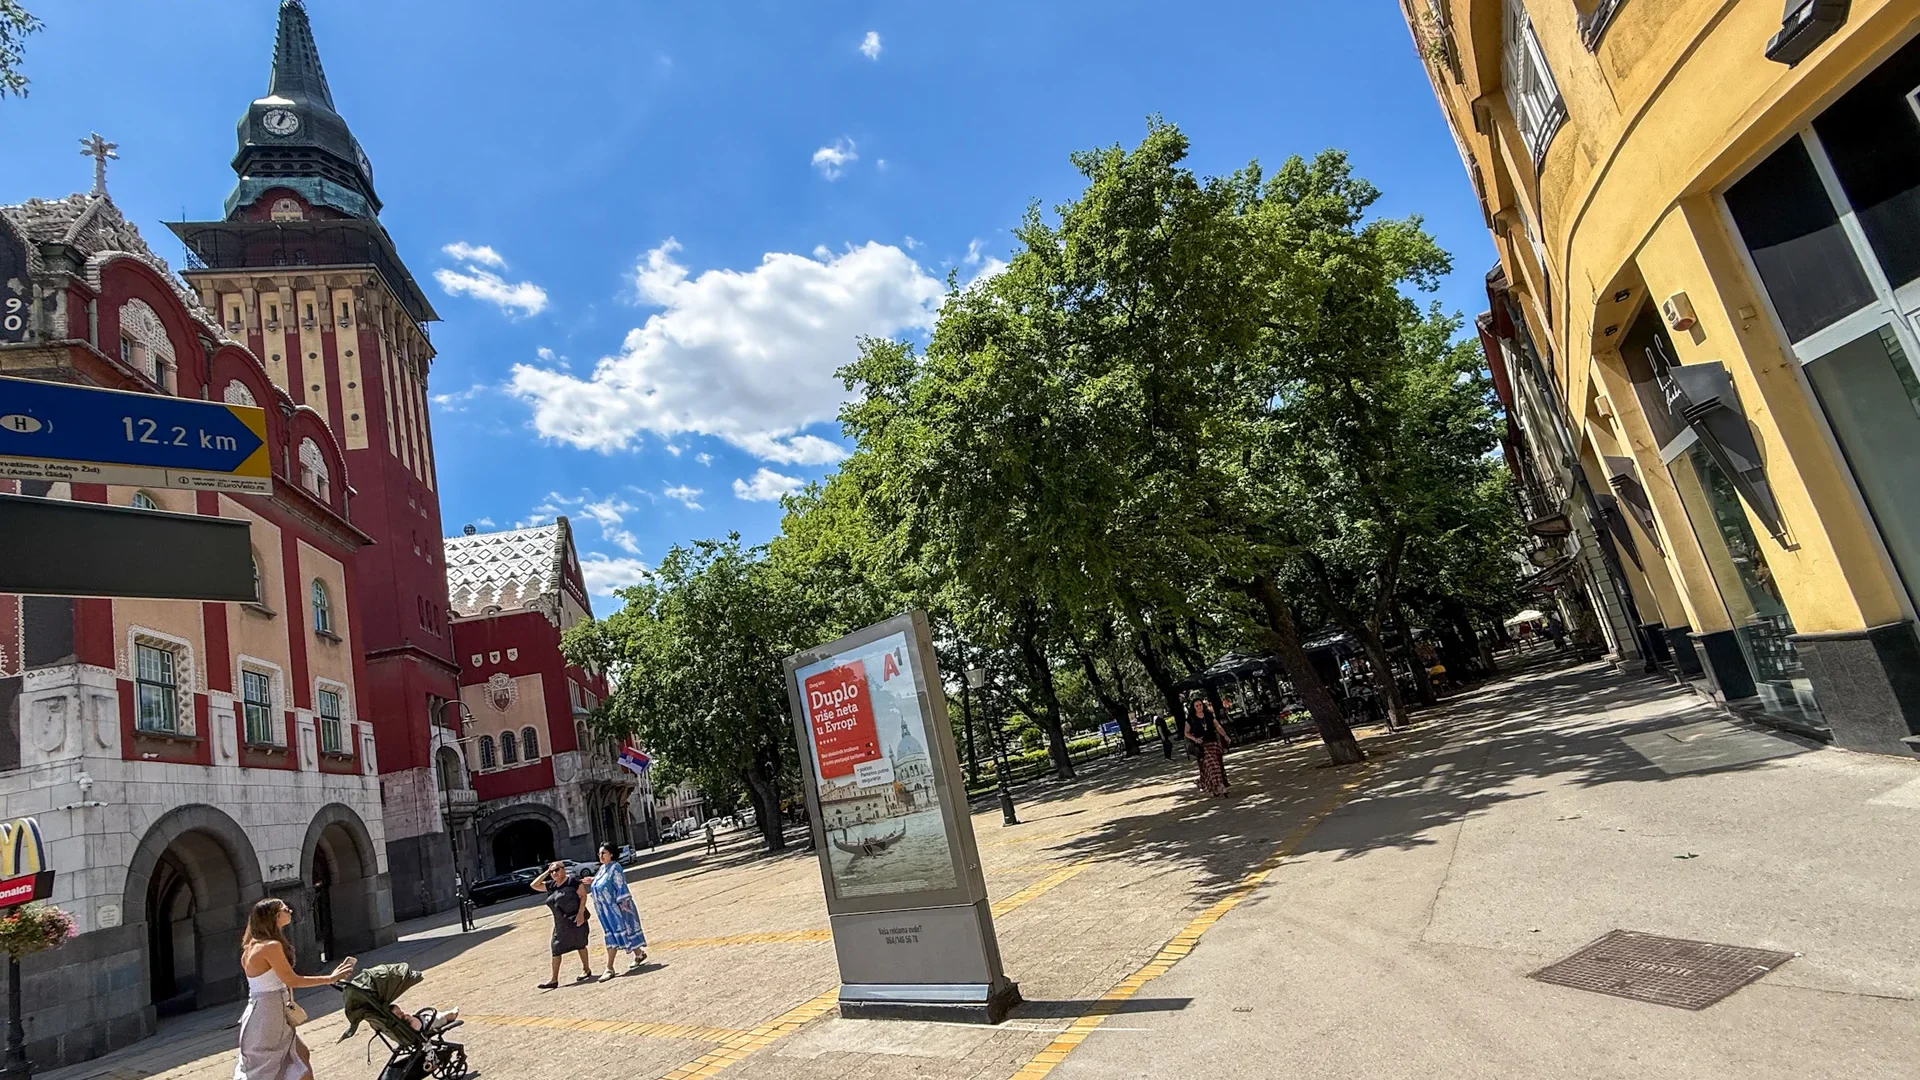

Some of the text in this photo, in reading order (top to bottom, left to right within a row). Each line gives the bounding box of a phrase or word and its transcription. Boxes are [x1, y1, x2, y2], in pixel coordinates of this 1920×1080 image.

[14, 416, 27, 431] H
[122, 416, 237, 451] 12.2 km
[193, 481, 265, 490] www.EuroVelo.rs
[884, 646, 903, 682] A1
[810, 682, 858, 710] Duplo
[815, 703, 859, 723] više neta
[816, 714, 857, 735] u Evropi
